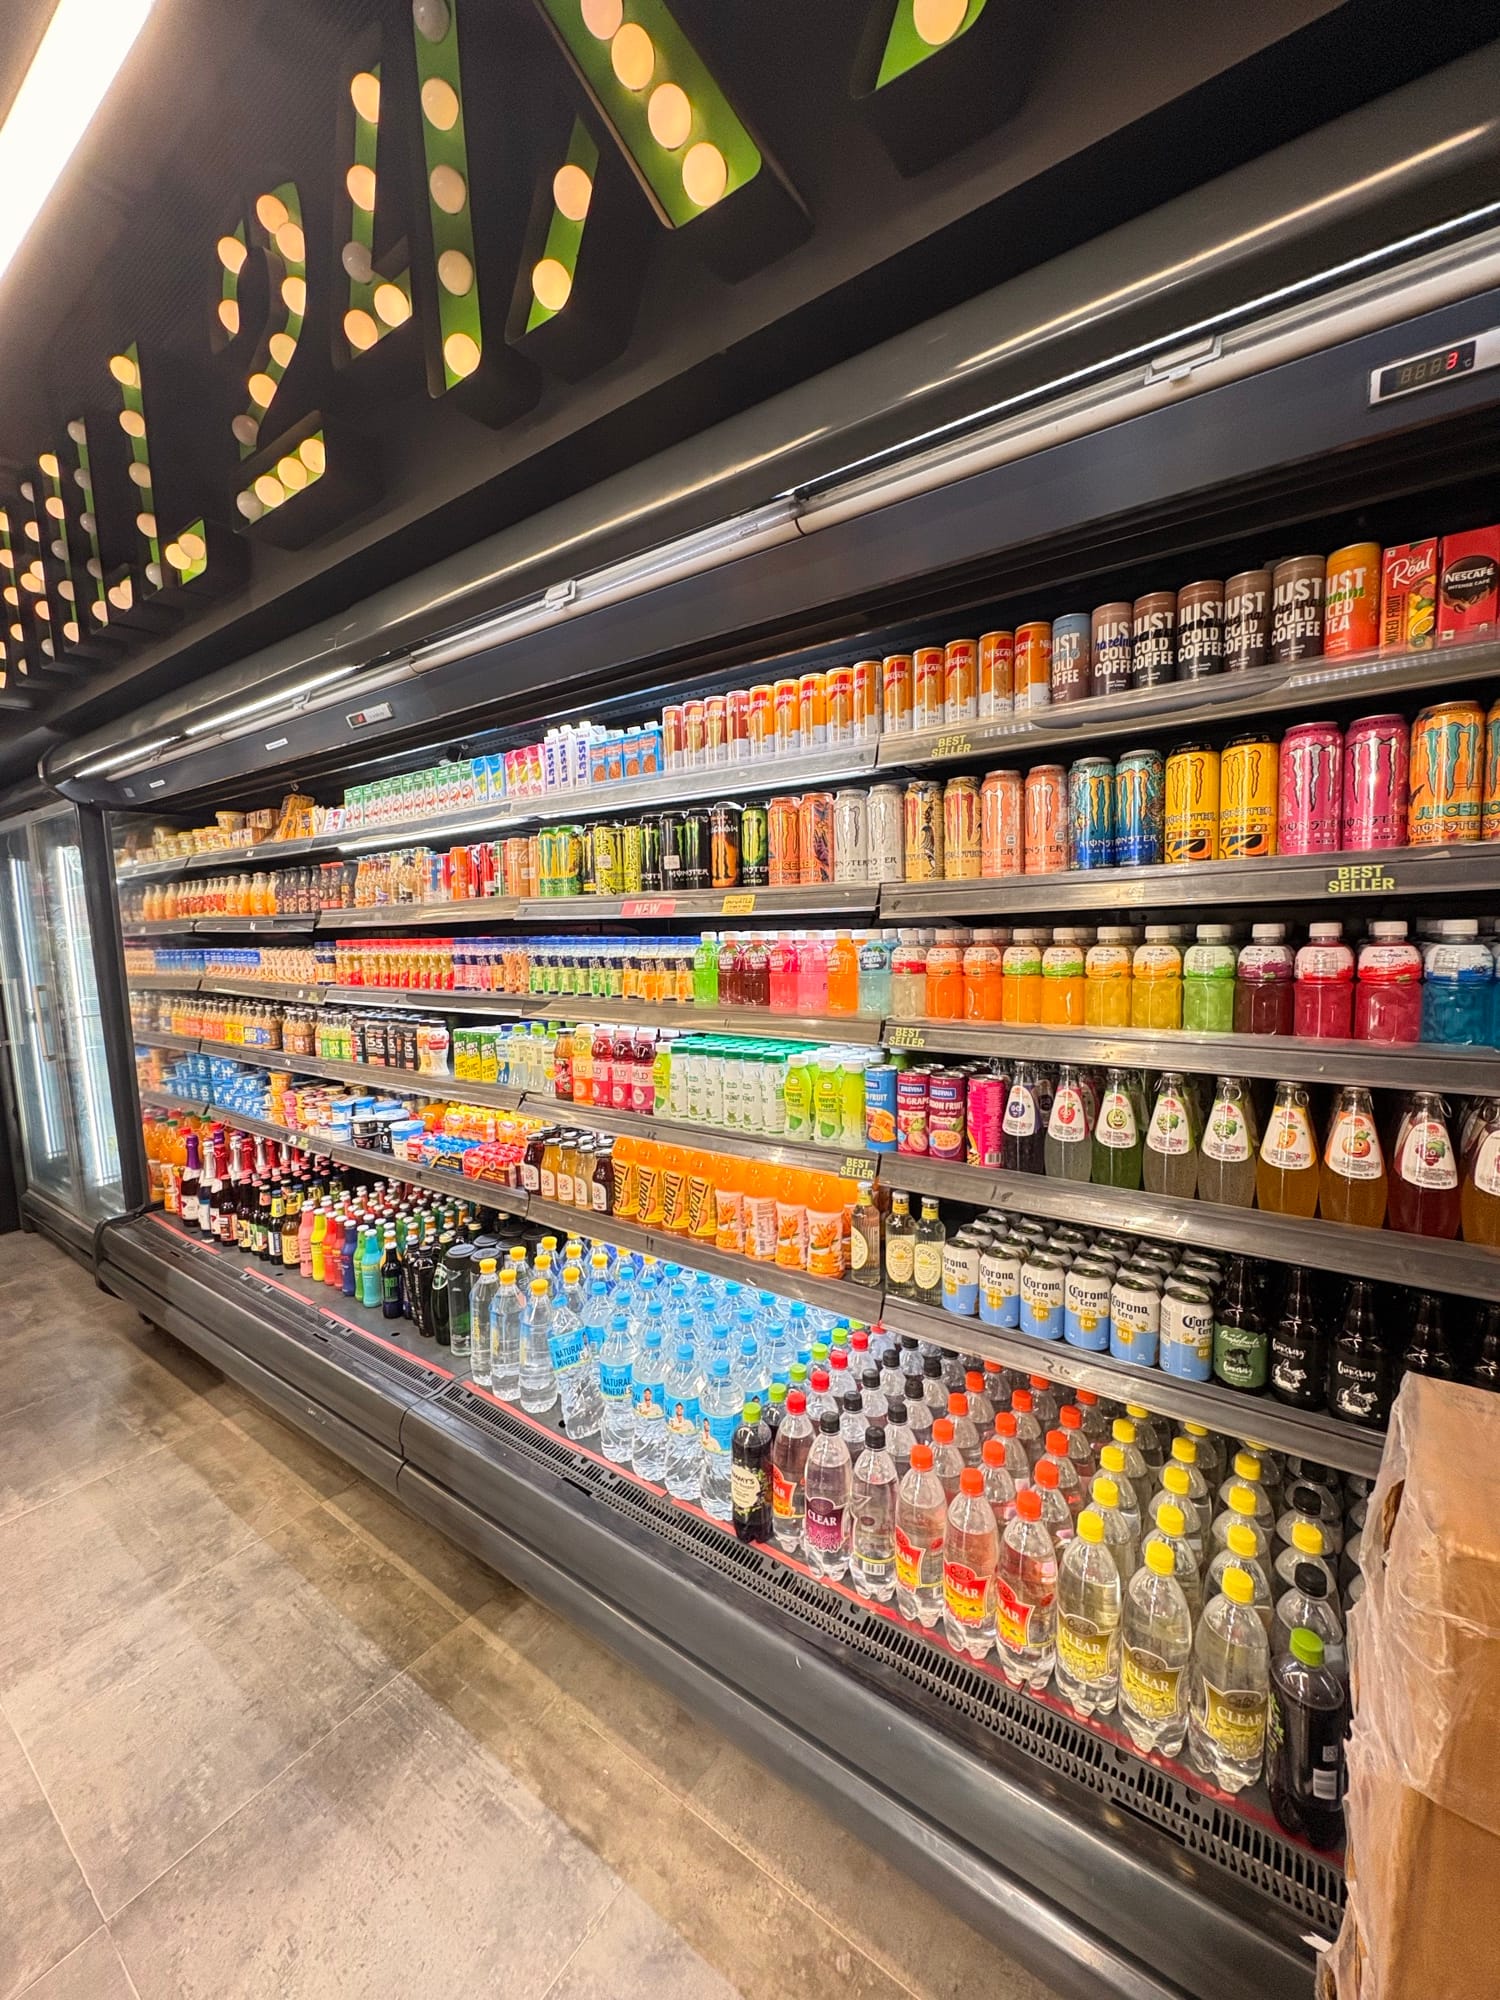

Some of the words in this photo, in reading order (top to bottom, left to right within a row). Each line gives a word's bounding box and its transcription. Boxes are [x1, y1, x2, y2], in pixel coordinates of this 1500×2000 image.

[1387, 547, 1434, 589] Real
[1445, 563, 1496, 583] NESCAFÉ
[1273, 578, 1322, 611] JUST
[1180, 602, 1223, 626] JUST
[1274, 606, 1316, 628] COLD
[1182, 627, 1218, 645] COLD
[1272, 622, 1320, 646] COFFEE
[1135, 637, 1169, 656] COLD
[938, 734, 967, 746] BEST
[931, 743, 972, 758] SELLER
[1338, 865, 1384, 879] BEST
[1328, 878, 1395, 893] SELLER
[634, 903, 660, 915] NEW
[895, 1027, 921, 1037] BEST
[888, 1036, 925, 1047] SELLER
[846, 1157, 871, 1169] BEST
[840, 1167, 874, 1180] SELLER
[981, 1264, 1015, 1281] Corona
[1023, 1275, 1061, 1291] Corona
[1069, 1284, 1109, 1300] Corona
[1111, 1293, 1149, 1315] Corona
[555, 1343, 583, 1358] NATURAL
[603, 1377, 631, 1386] NATURAL
[808, 1509, 837, 1527] CLEAR
[947, 1574, 979, 1599] CLEAR
[1062, 1627, 1101, 1654] CLEAR
[1127, 1660, 1169, 1692] CLEAR
[1217, 1706, 1262, 1726] CLEAR
